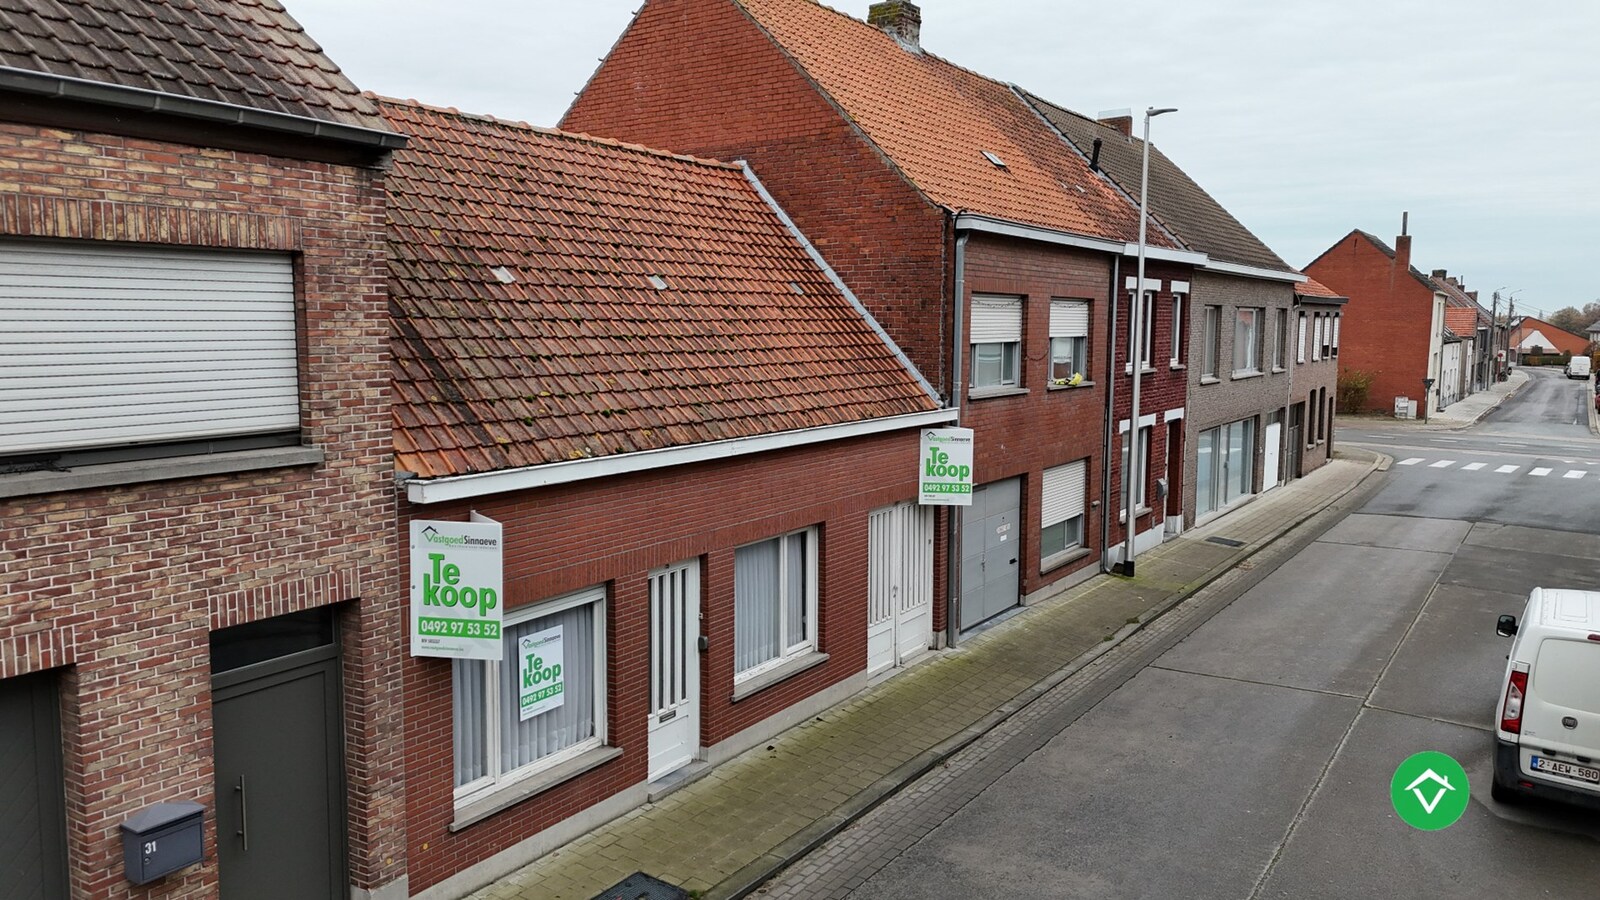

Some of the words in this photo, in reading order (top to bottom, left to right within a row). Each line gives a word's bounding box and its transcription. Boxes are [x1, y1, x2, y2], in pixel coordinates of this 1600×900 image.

[930, 446, 948, 464] Te
[926, 458, 970, 481] koop
[428, 553, 460, 585] Te
[423, 573, 497, 616] koop
[421, 620, 447, 632] 0492
[451, 621, 464, 634] 97
[467, 623, 480, 635] 53
[484, 624, 497, 636] 52
[526, 653, 543, 673] Te
[523, 664, 562, 689] koop
[522, 694, 536, 705] 0492
[538, 691, 546, 700] 97
[546, 687, 554, 696] 53
[554, 684, 562, 693] 52
[145, 841, 157, 854] 31
